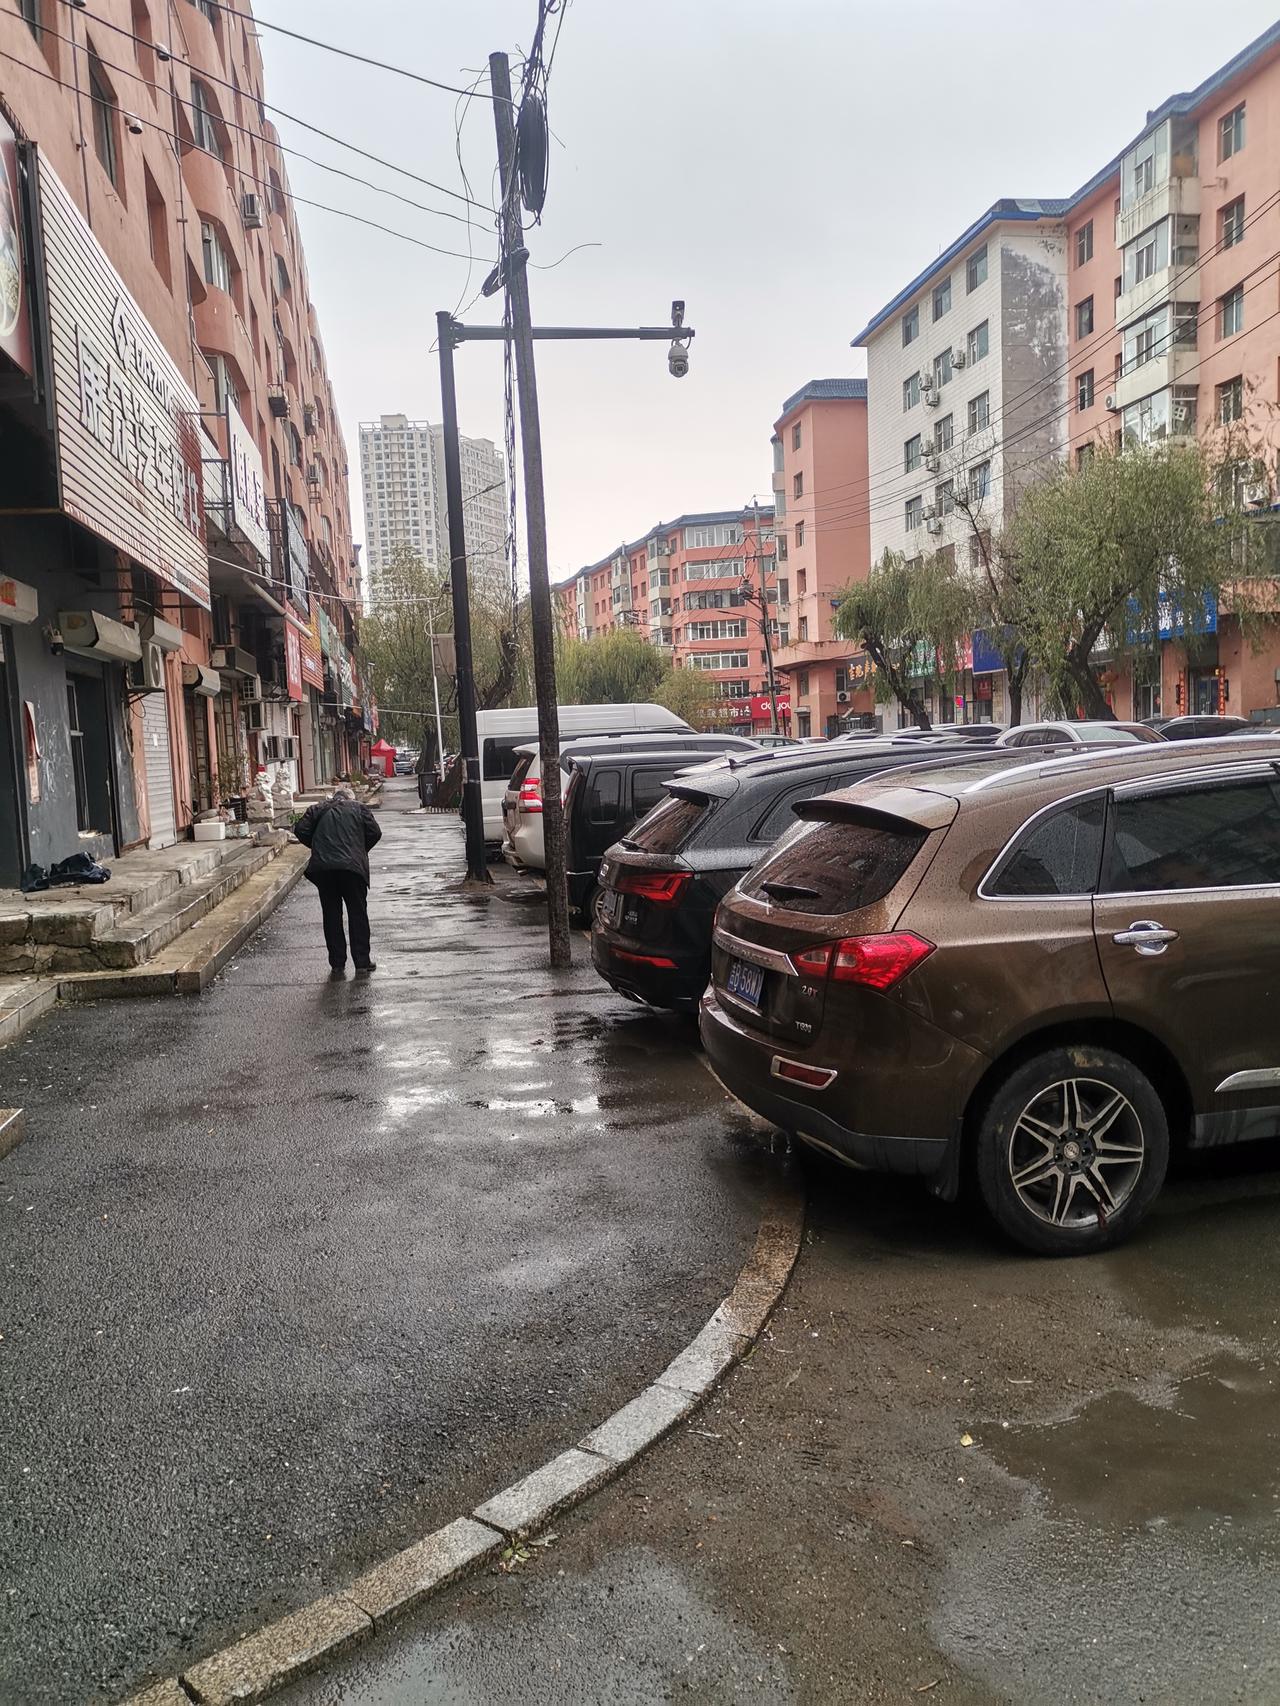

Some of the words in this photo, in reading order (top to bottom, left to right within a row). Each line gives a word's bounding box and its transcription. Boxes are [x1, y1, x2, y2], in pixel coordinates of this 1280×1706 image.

[75, 323, 200, 537] 康众汽车配件
